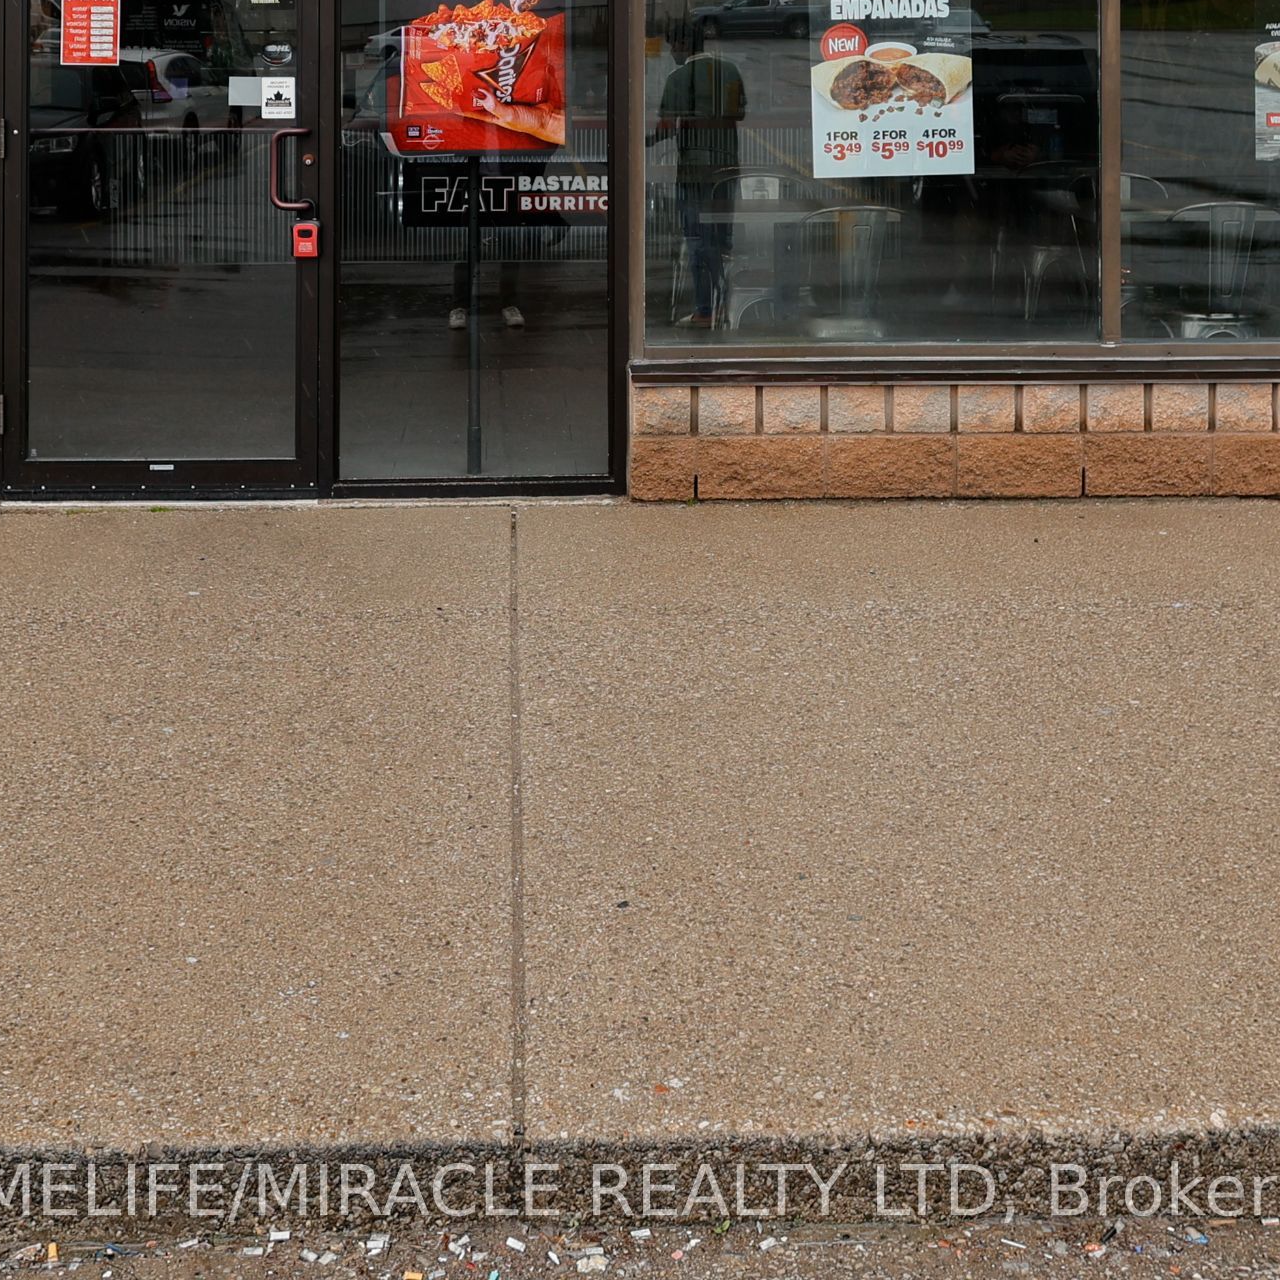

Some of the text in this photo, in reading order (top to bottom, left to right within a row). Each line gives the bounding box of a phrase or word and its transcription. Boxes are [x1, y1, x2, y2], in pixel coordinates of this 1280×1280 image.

[828, 35, 860, 54] NEW!
[827, 131, 858, 141] 1 FOR
[873, 130, 907, 140] 2 FOR
[922, 129, 957, 139] 4 FOR
[421, 176, 515, 212] FAT
